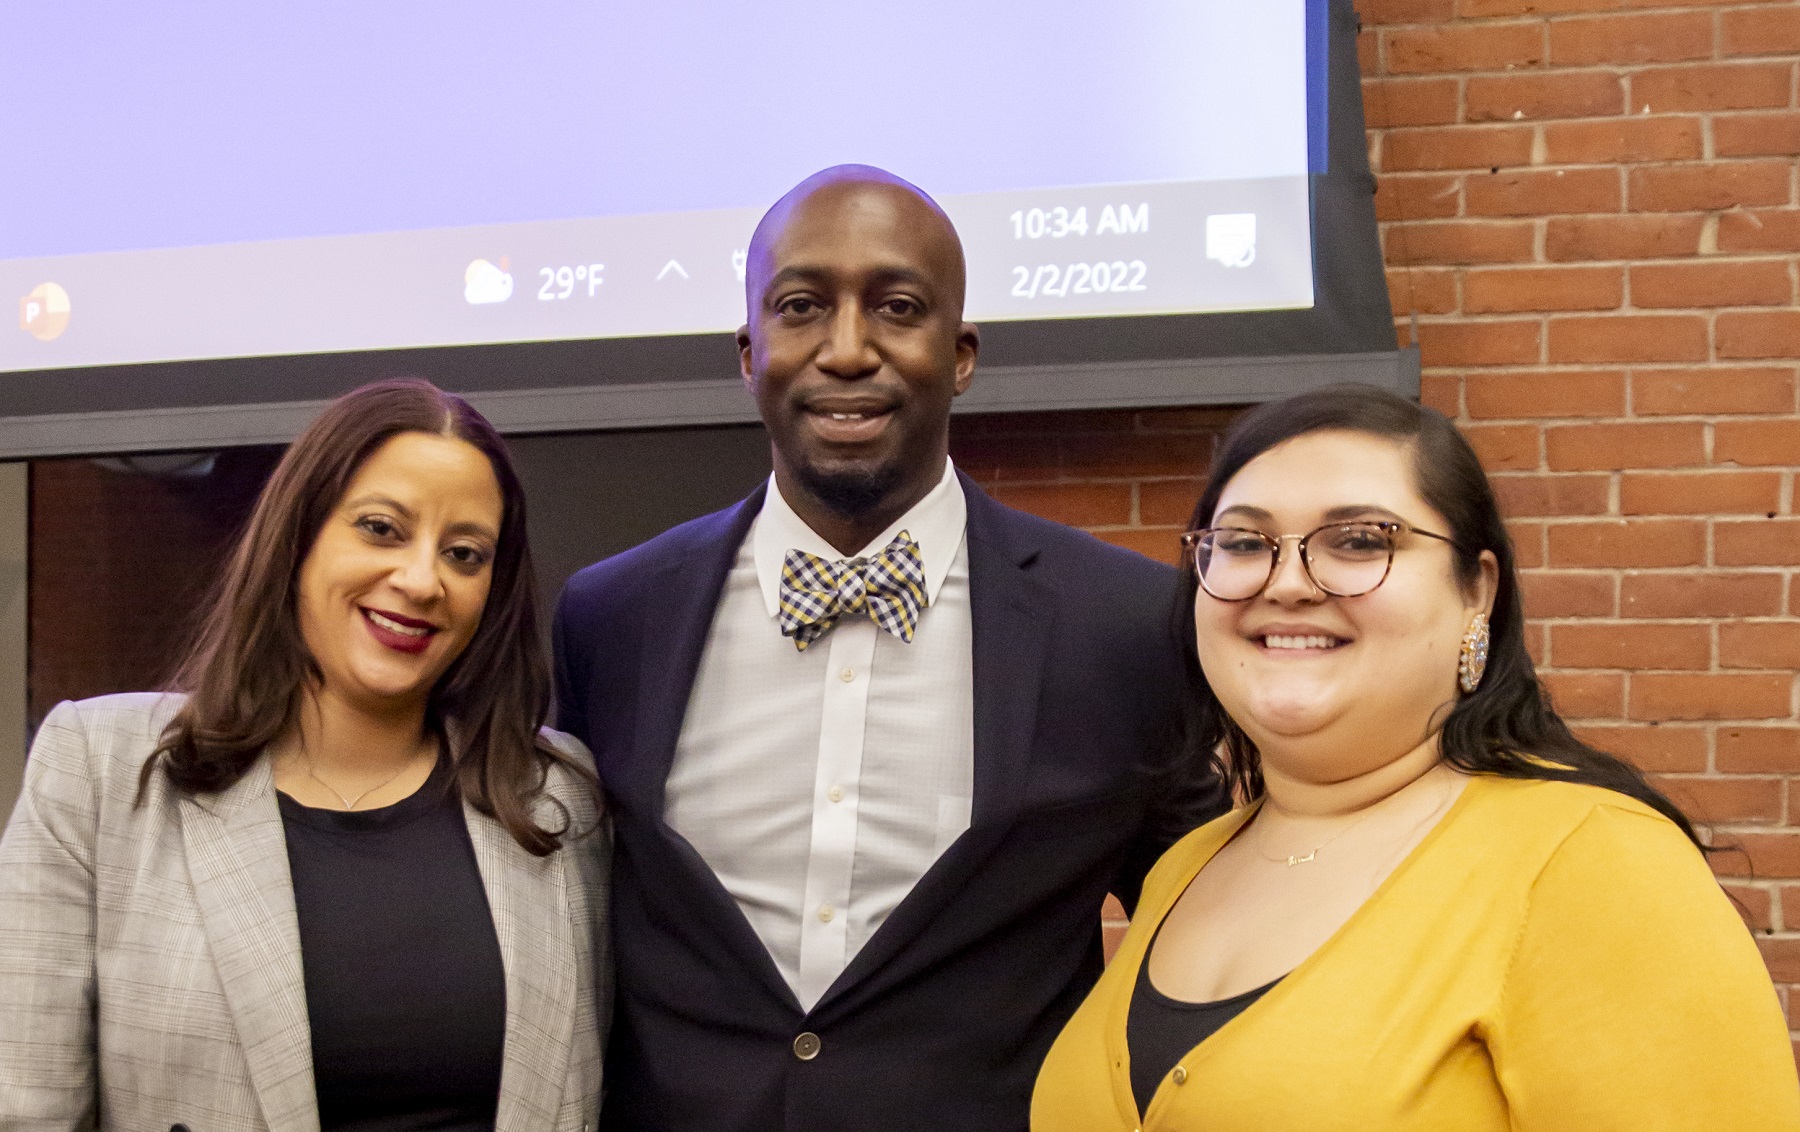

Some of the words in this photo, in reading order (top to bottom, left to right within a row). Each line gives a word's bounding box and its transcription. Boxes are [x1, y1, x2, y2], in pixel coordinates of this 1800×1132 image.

[1010, 206, 1089, 239] 10:34
[1096, 203, 1149, 235] AM
[537, 263, 605, 300] 29°F
[1011, 259, 1148, 299] 2/2/2022
[26, 302, 40, 323] P
